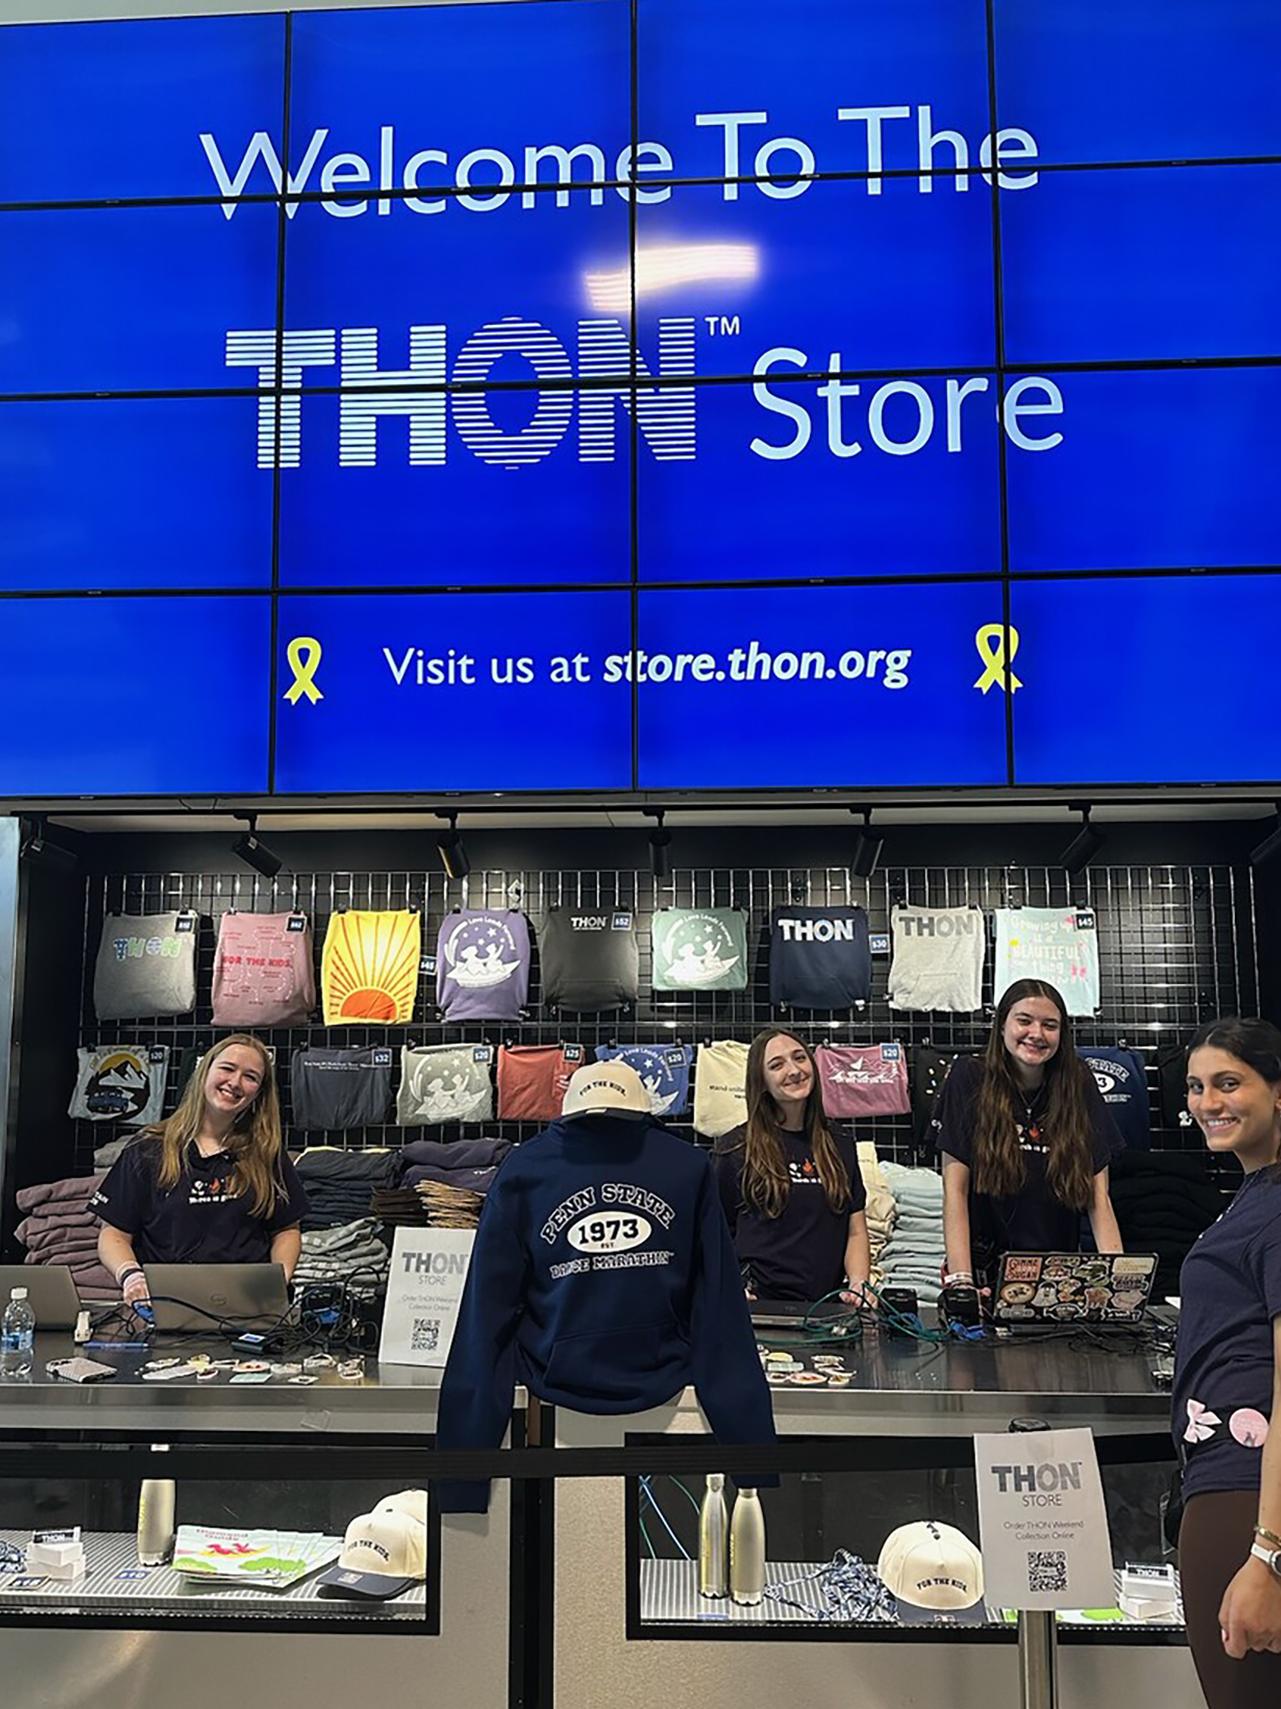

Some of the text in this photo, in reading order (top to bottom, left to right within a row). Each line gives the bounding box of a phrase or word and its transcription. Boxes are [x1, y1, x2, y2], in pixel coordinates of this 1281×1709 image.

[199, 105, 1039, 220] Welcome To The
[225, 316, 697, 470] THON
[750, 347, 1064, 460] Store
[383, 641, 912, 690] Visit us at store.thon.org
[571, 916, 606, 928] THON
[778, 918, 855, 942] THON
[899, 914, 974, 938] THON
[112, 936, 182, 960] THON
[221, 955, 242, 965] FOR
[246, 956, 266, 967] THE
[883, 1047, 898, 1058] $20
[540, 1183, 676, 1245] PENN STATE
[578, 1218, 639, 1245] 1973
[402, 1252, 466, 1274] THON
[418, 1274, 447, 1286] STORE
[991, 1462, 1082, 1493] THON
[1022, 1494, 1063, 1507] STORE
[1003, 1520, 1084, 1530] Order THON Weekend
[1015, 1531, 1075, 1541] Collection Online
[360, 1539, 372, 1548] THE
[916, 1578, 932, 1591] FOR
[933, 1577, 950, 1585] THE
